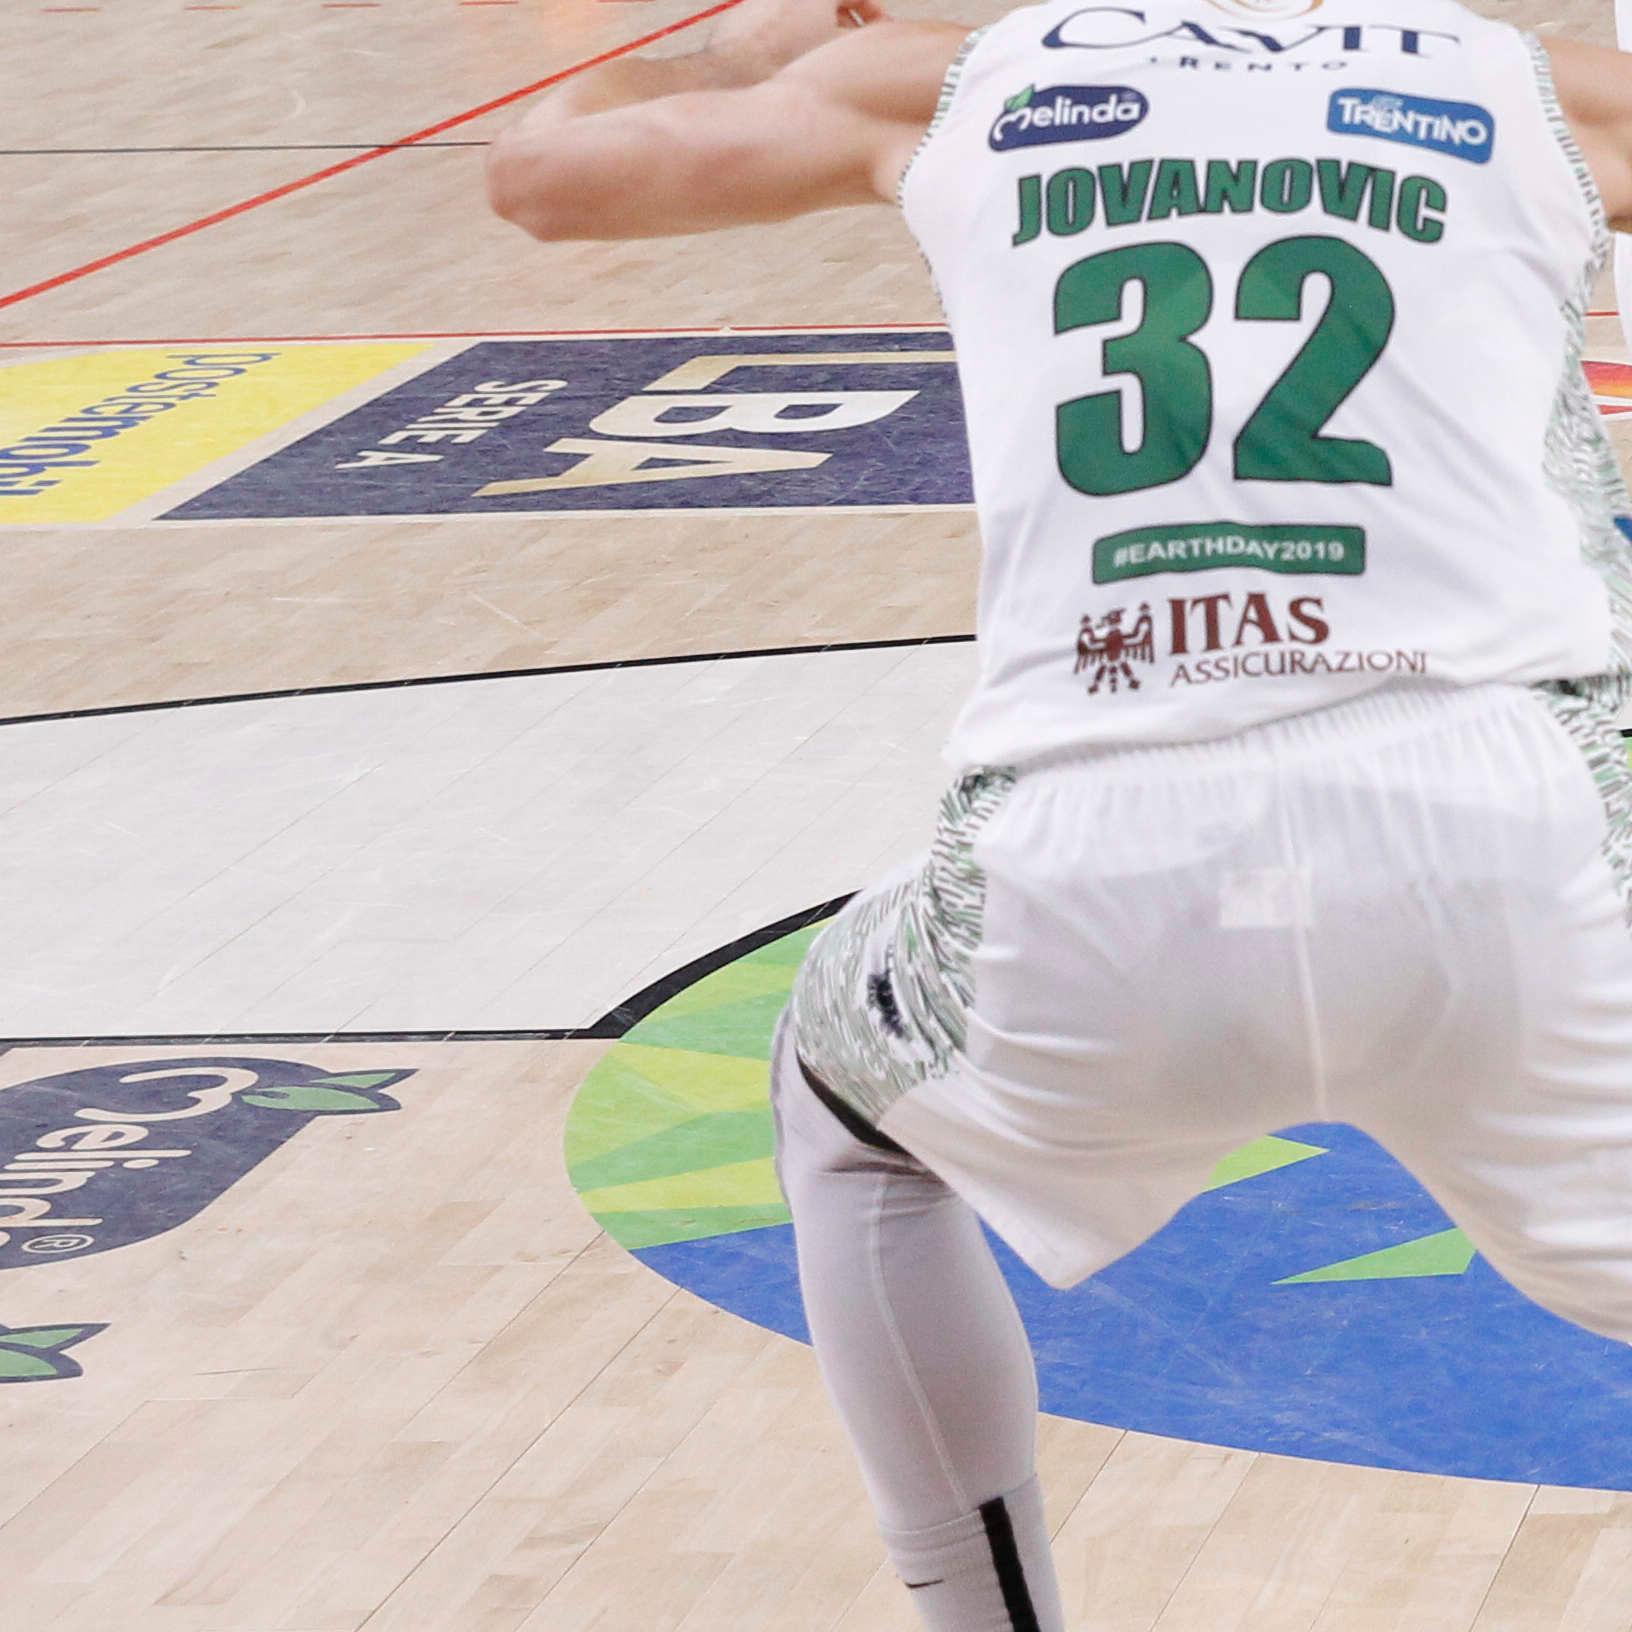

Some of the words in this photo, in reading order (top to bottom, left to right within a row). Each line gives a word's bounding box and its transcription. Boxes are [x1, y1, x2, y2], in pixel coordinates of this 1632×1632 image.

[1040, 6, 1460, 57] CAVIT
[1336, 95, 1489, 147] TRENTINO
[1012, 158, 1448, 247] JOVANOVIC
[1054, 234, 1396, 497] 32
[408, 378, 568, 445] SERIE
[1111, 535, 1346, 567] #EARTHDAY2019
[1167, 591, 1331, 657] ITAS
[1169, 646, 1429, 688] ASSICURAZIONI
